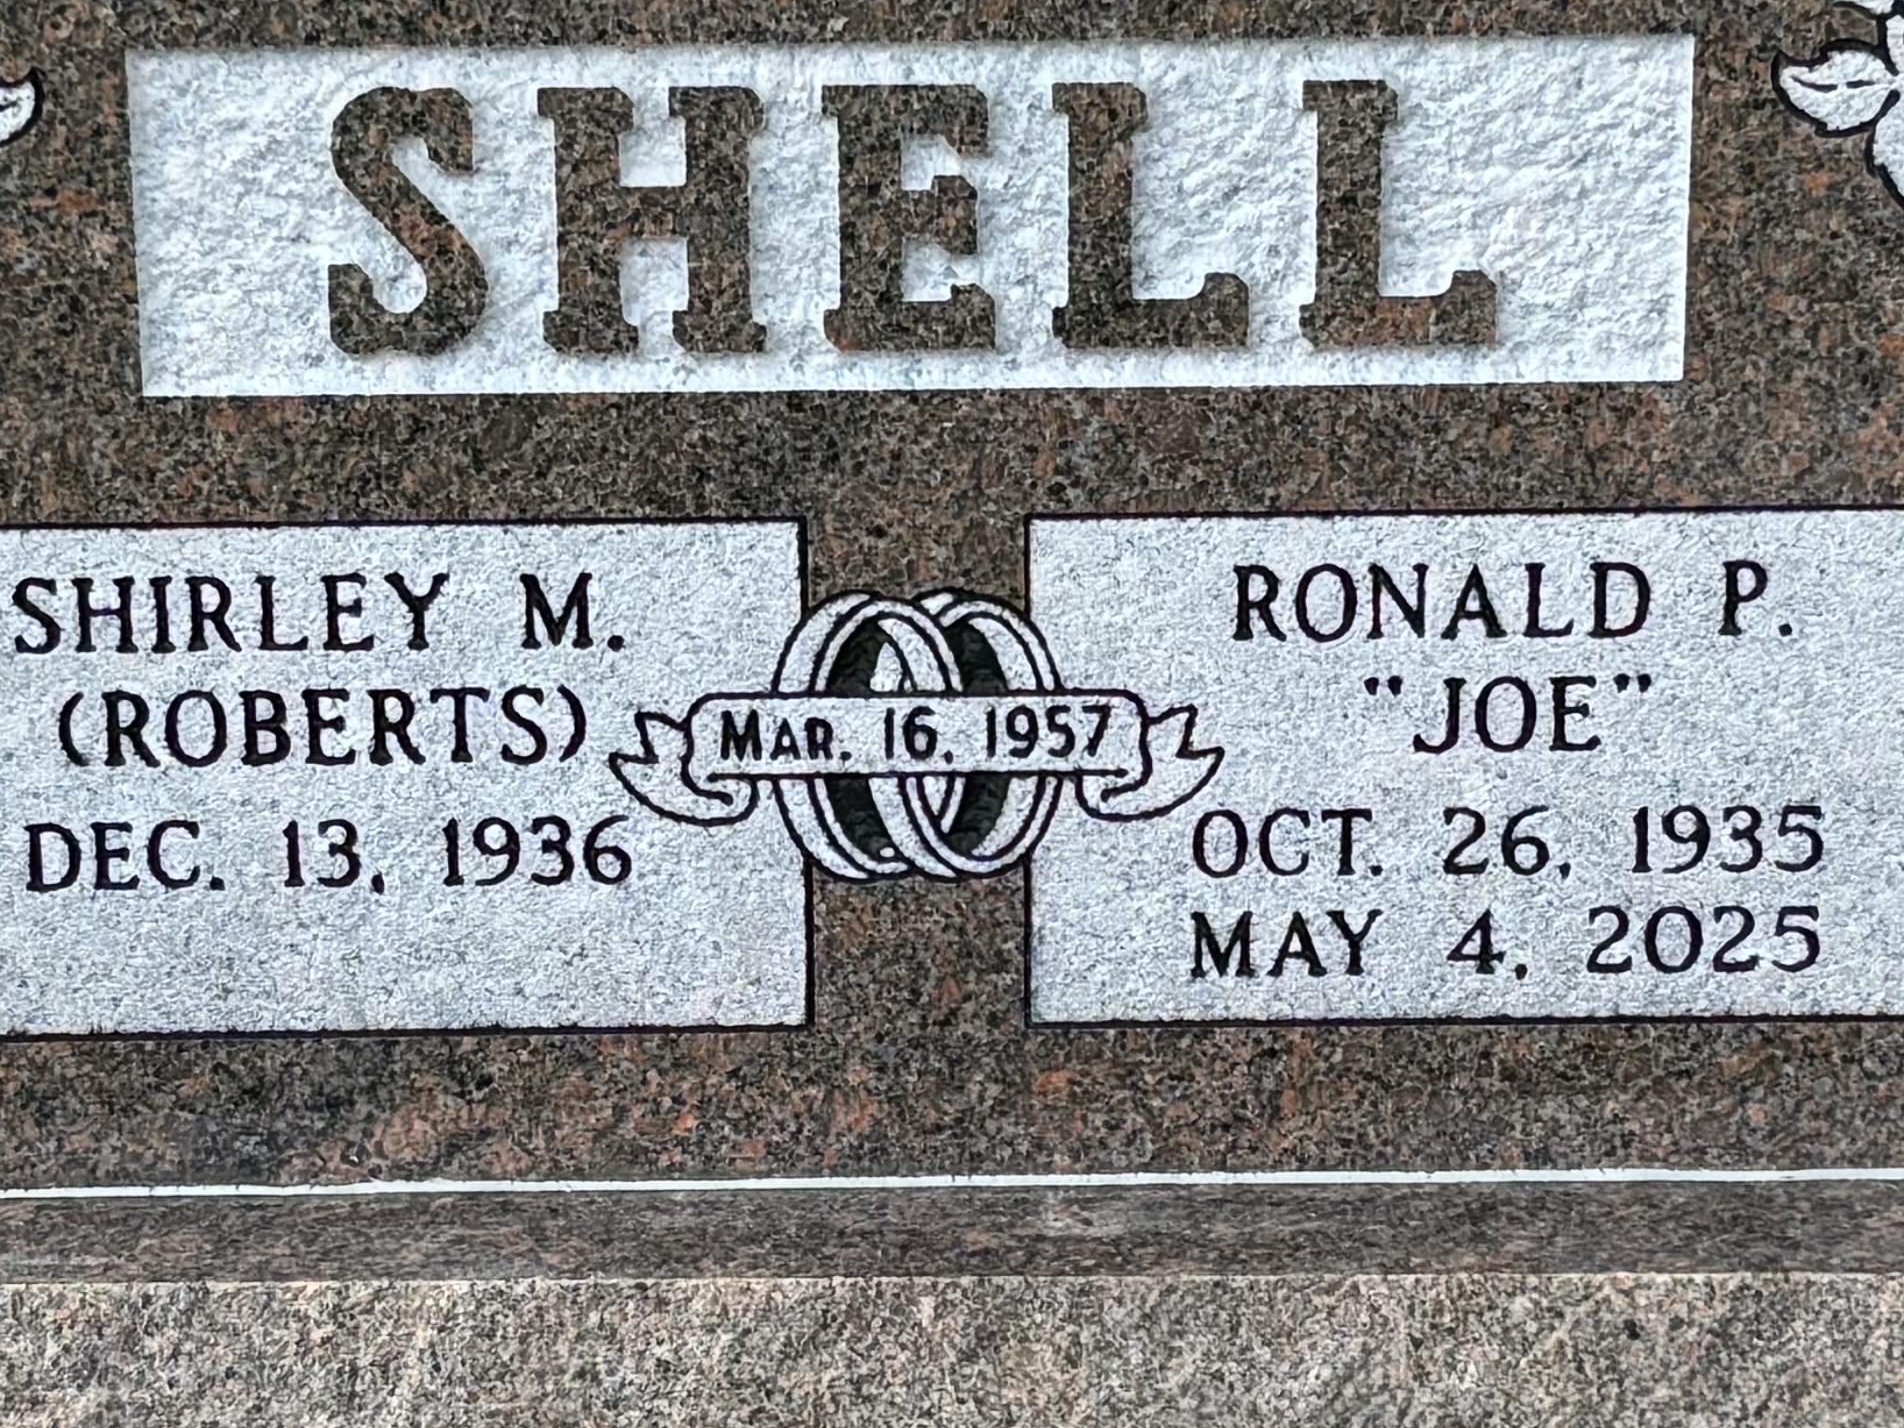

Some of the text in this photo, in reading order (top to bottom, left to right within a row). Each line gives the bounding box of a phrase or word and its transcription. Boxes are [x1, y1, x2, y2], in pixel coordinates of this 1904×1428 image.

[327, 78, 1498, 361] SHELL
[11, 570, 625, 655] SHIRLEY M.
[1231, 558, 1793, 644] RONALD P.
[56, 683, 588, 769] (ROBERTS)
[882, 704, 954, 765] 16,
[985, 702, 1113, 760] 1957
[1363, 672, 1653, 756] "JOE"
[23, 814, 634, 895] DEC. 13, 1936
[1191, 802, 1825, 880] OCT. 26, 1935
[1189, 903, 1821, 982] MAY 4, 2025
